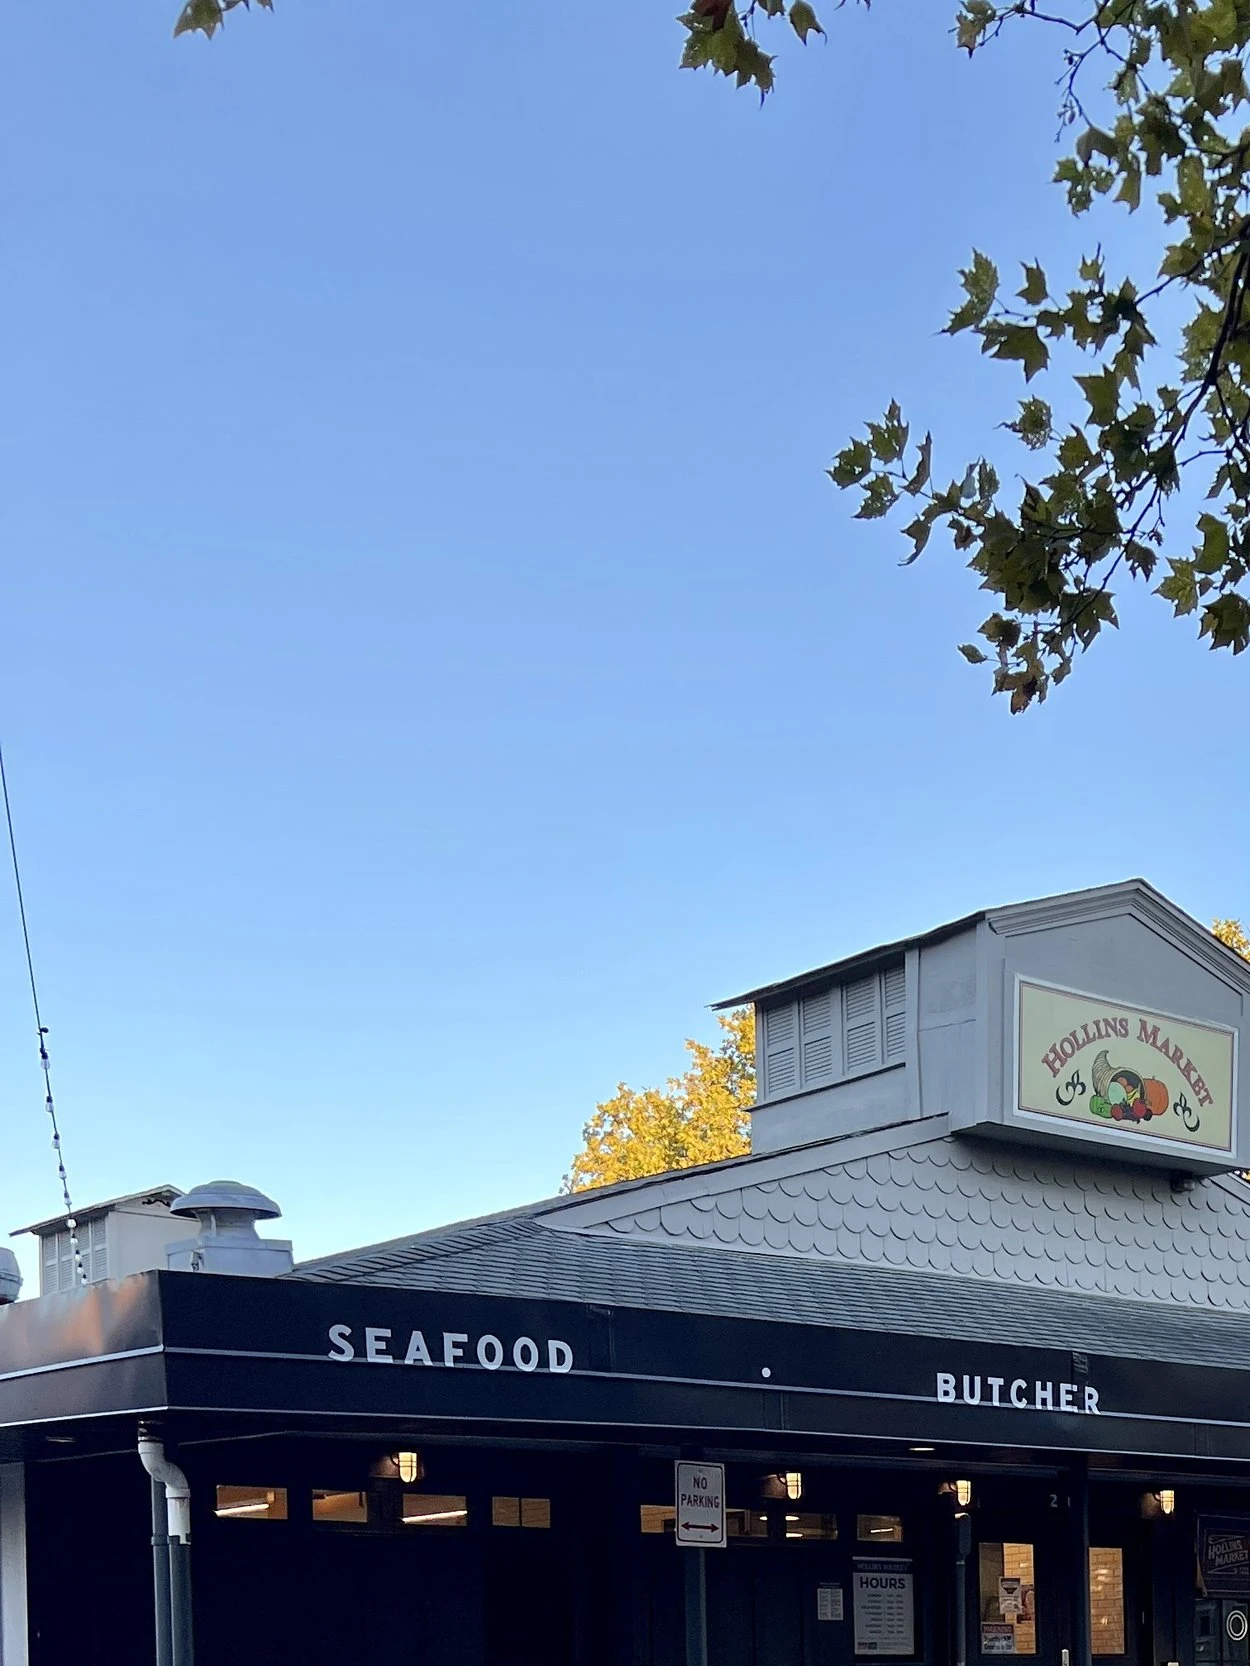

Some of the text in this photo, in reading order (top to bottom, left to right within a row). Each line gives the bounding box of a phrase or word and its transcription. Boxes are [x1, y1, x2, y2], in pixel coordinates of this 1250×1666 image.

[1041, 1017, 1214, 1108] HOLLINS MARKET
[327, 1322, 575, 1375] SEAFOOD
[935, 1371, 1102, 1415] BUTCHER
[692, 1476, 708, 1490] NO
[680, 1493, 720, 1509] PARKING
[1207, 1538, 1243, 1560] HOLLINS
[1214, 1549, 1250, 1565] MARKET
[860, 1576, 906, 1589] HOURS
